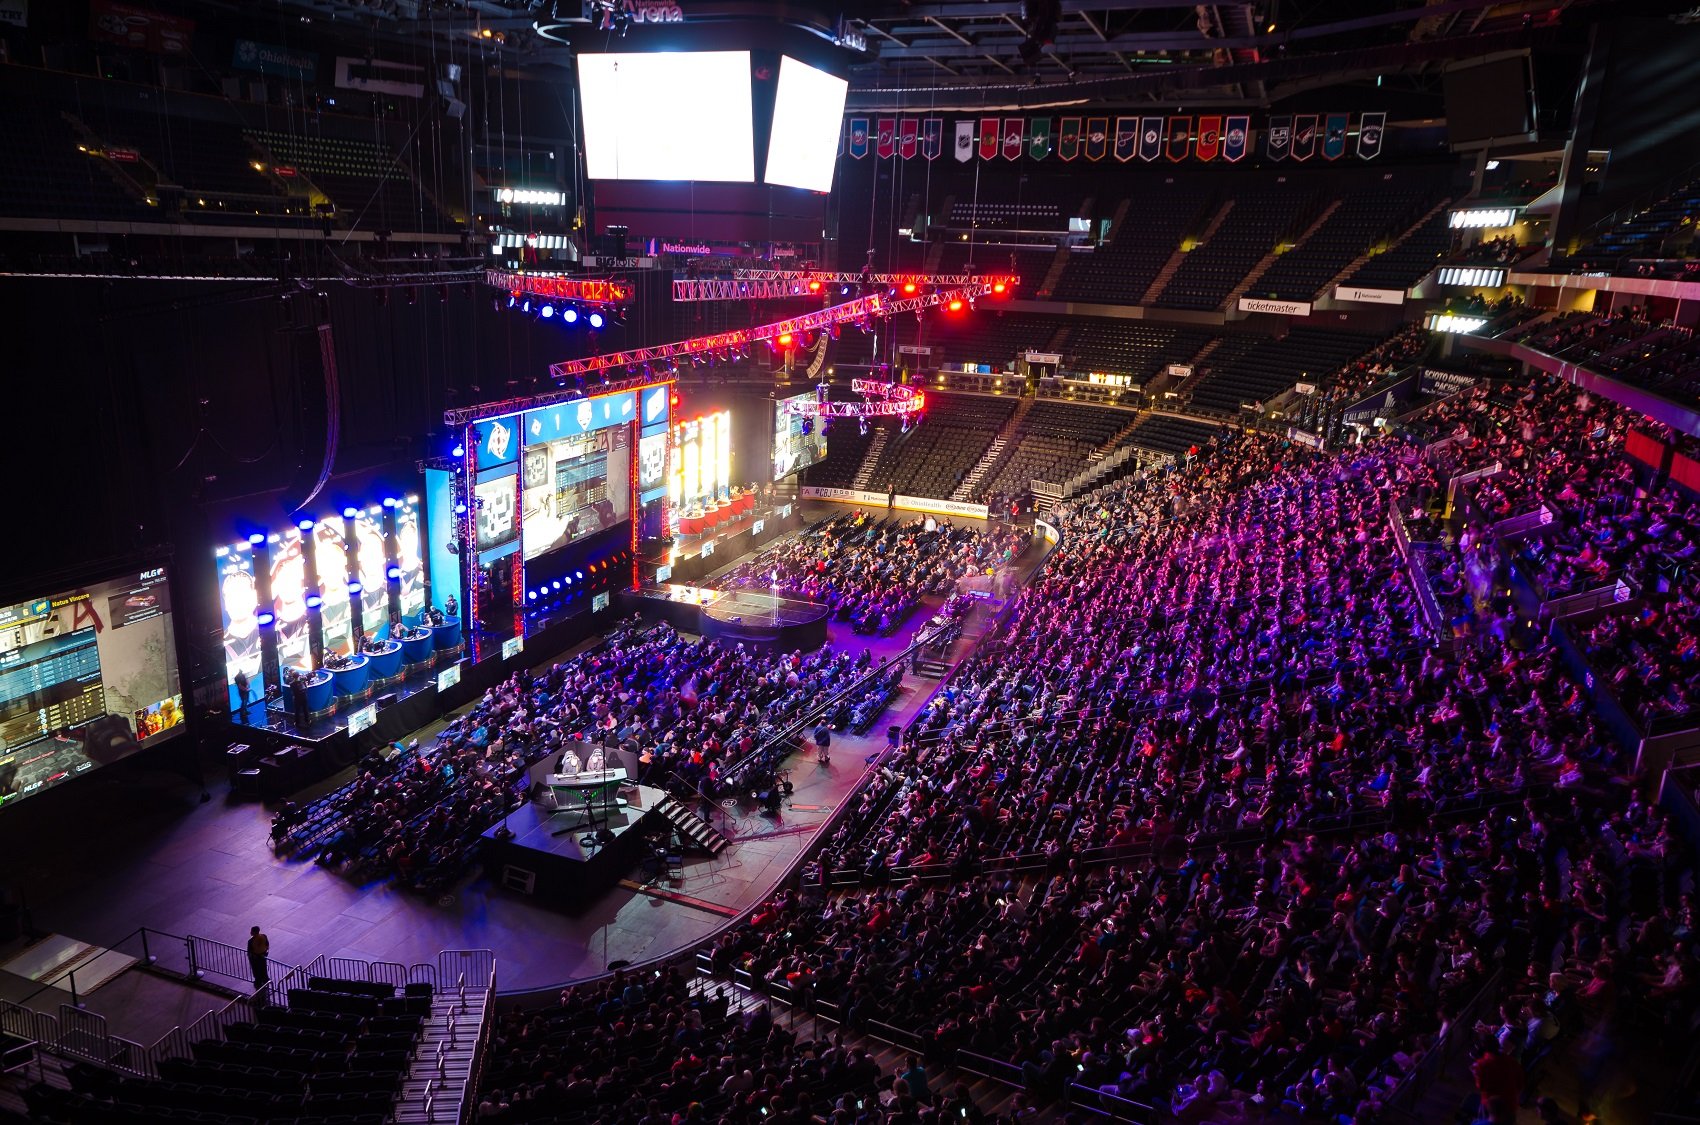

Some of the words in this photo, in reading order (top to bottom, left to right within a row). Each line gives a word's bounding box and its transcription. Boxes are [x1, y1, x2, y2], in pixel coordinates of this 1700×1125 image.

[258, 49, 313, 70] OhioHealth
[663, 243, 711, 255] Nationwide
[1247, 300, 1298, 315] ticketmaster
[1424, 369, 1448, 381] SCIOTO
[1448, 374, 1476, 386] DOWNS
[140, 569, 157, 581] MLG
[52, 599, 69, 608] Natus
[69, 593, 90, 603] Vincere
